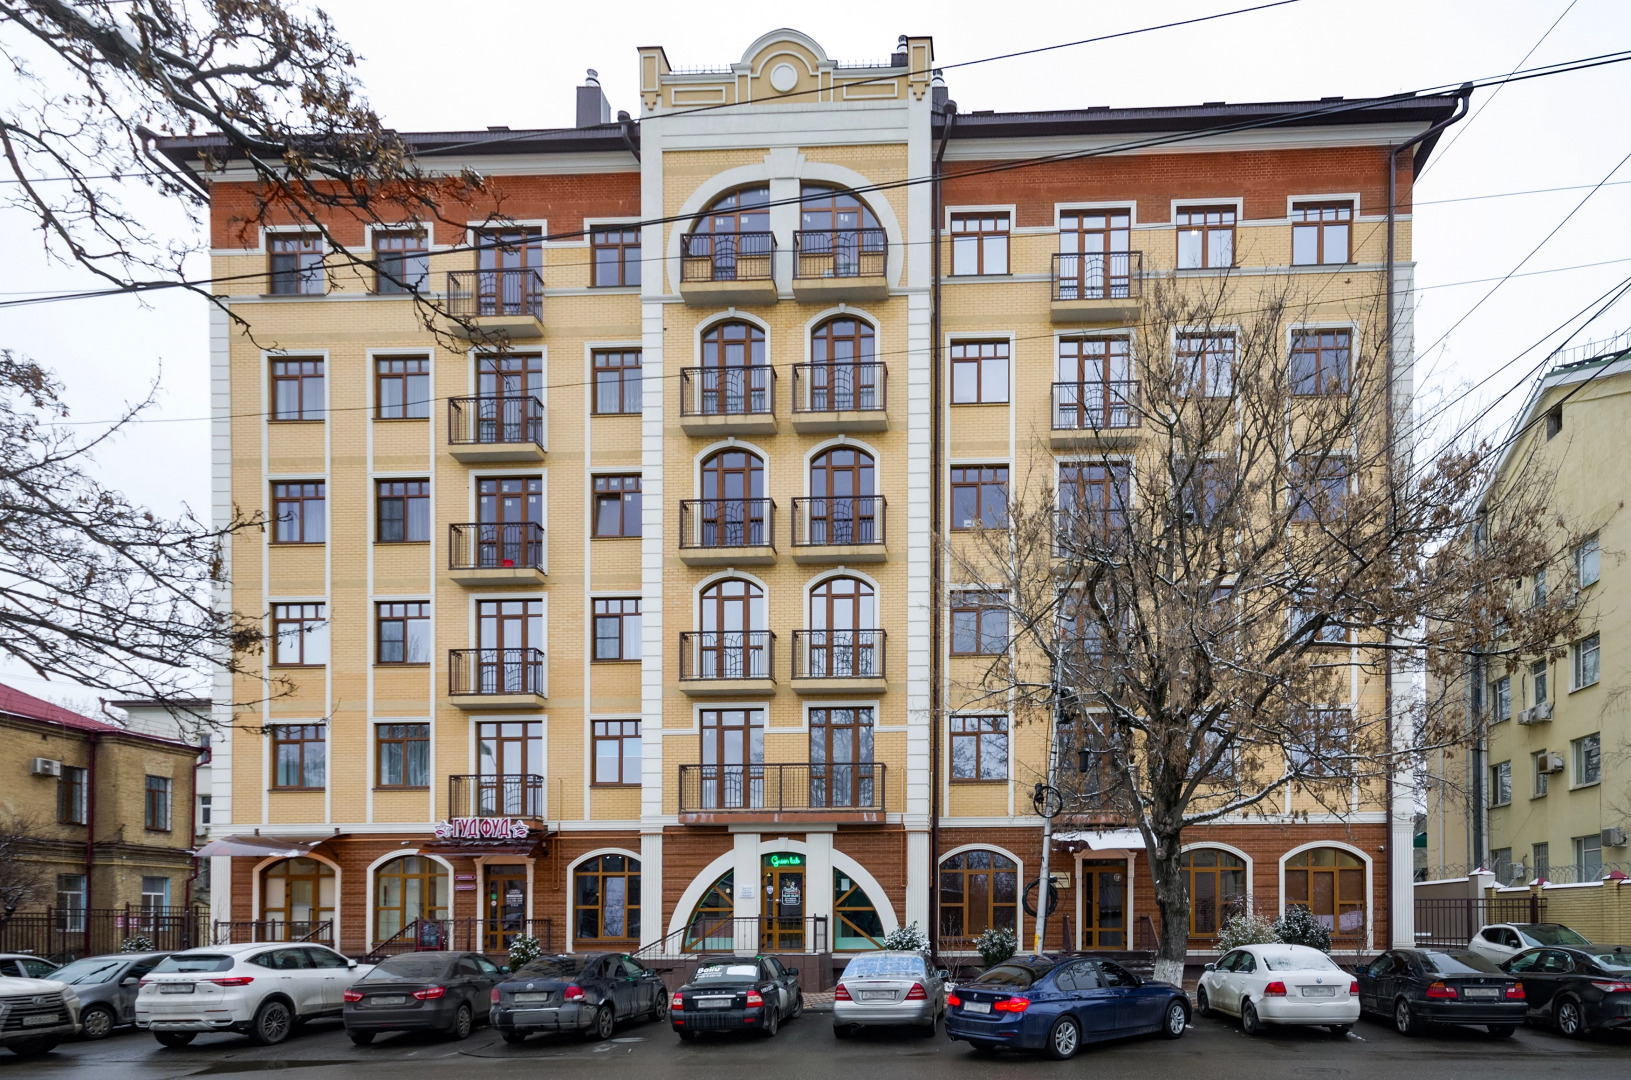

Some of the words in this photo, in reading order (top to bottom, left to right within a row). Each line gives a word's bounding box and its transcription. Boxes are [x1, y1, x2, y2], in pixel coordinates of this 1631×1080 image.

[453, 818, 479, 838] ГУД
[481, 818, 510, 838] ФУД
[771, 855, 789, 867] Green
